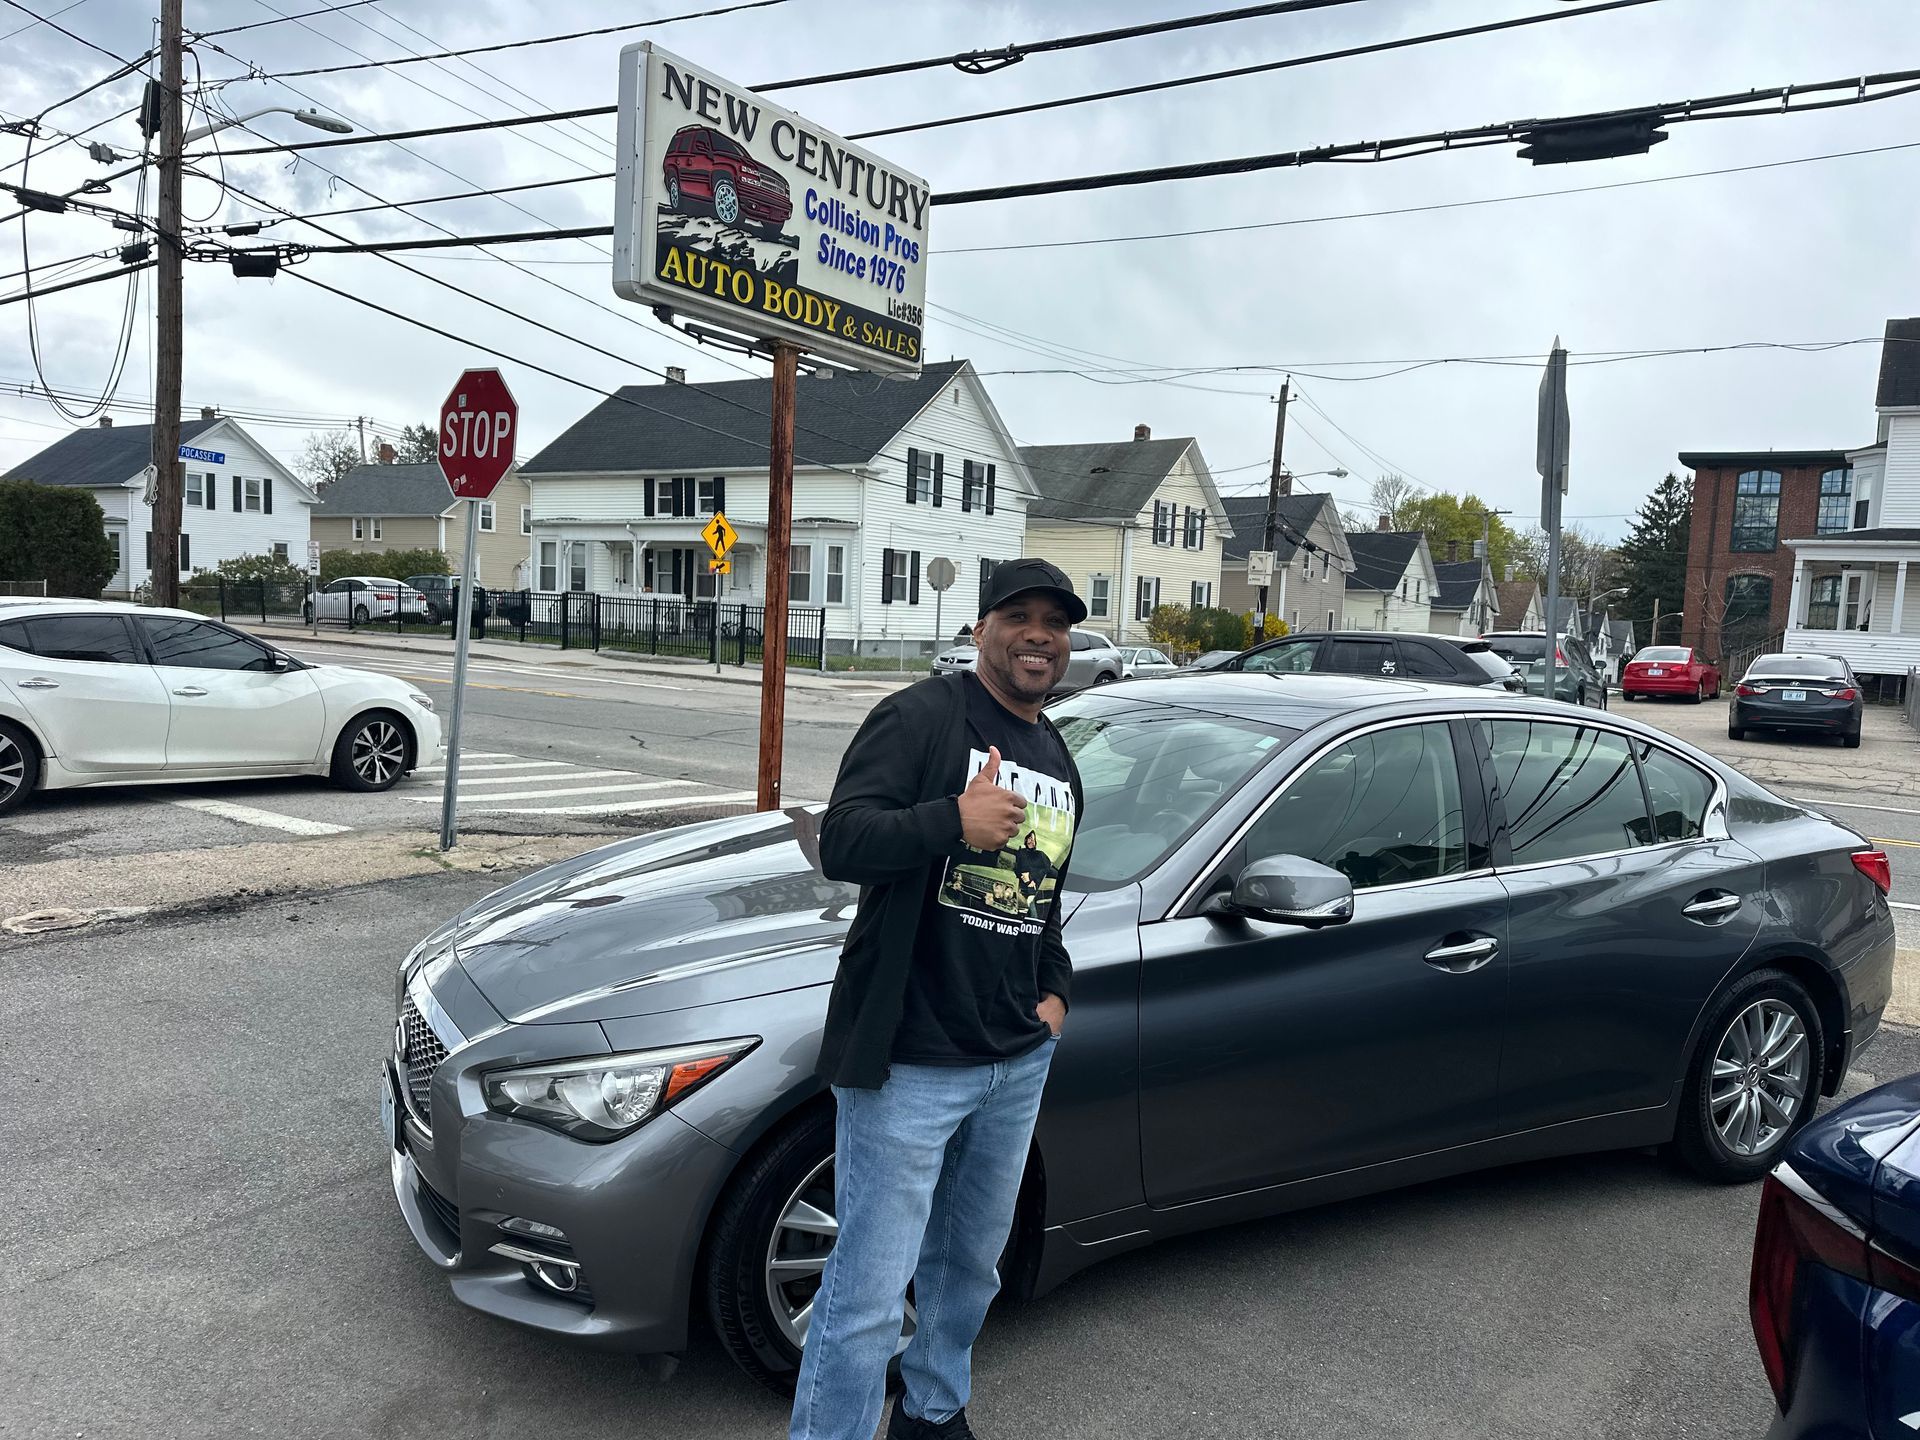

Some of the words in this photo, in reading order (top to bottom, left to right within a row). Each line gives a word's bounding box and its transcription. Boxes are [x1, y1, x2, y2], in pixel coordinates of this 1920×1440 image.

[662, 62, 760, 142] NEW
[770, 119, 931, 231] CENTURY
[805, 187, 880, 248] Collision
[884, 222, 920, 264] Pros
[817, 233, 866, 280] Since
[869, 254, 906, 294] 1976
[660, 246, 755, 304] AUTO
[762, 278, 841, 333] BODY
[842, 315, 857, 340] &
[861, 321, 918, 359] SALES
[887, 297, 923, 326] Lic#356
[181, 447, 216, 462] POCASSET
[443, 410, 511, 459] STOP
[996, 923, 1020, 937] WAS
